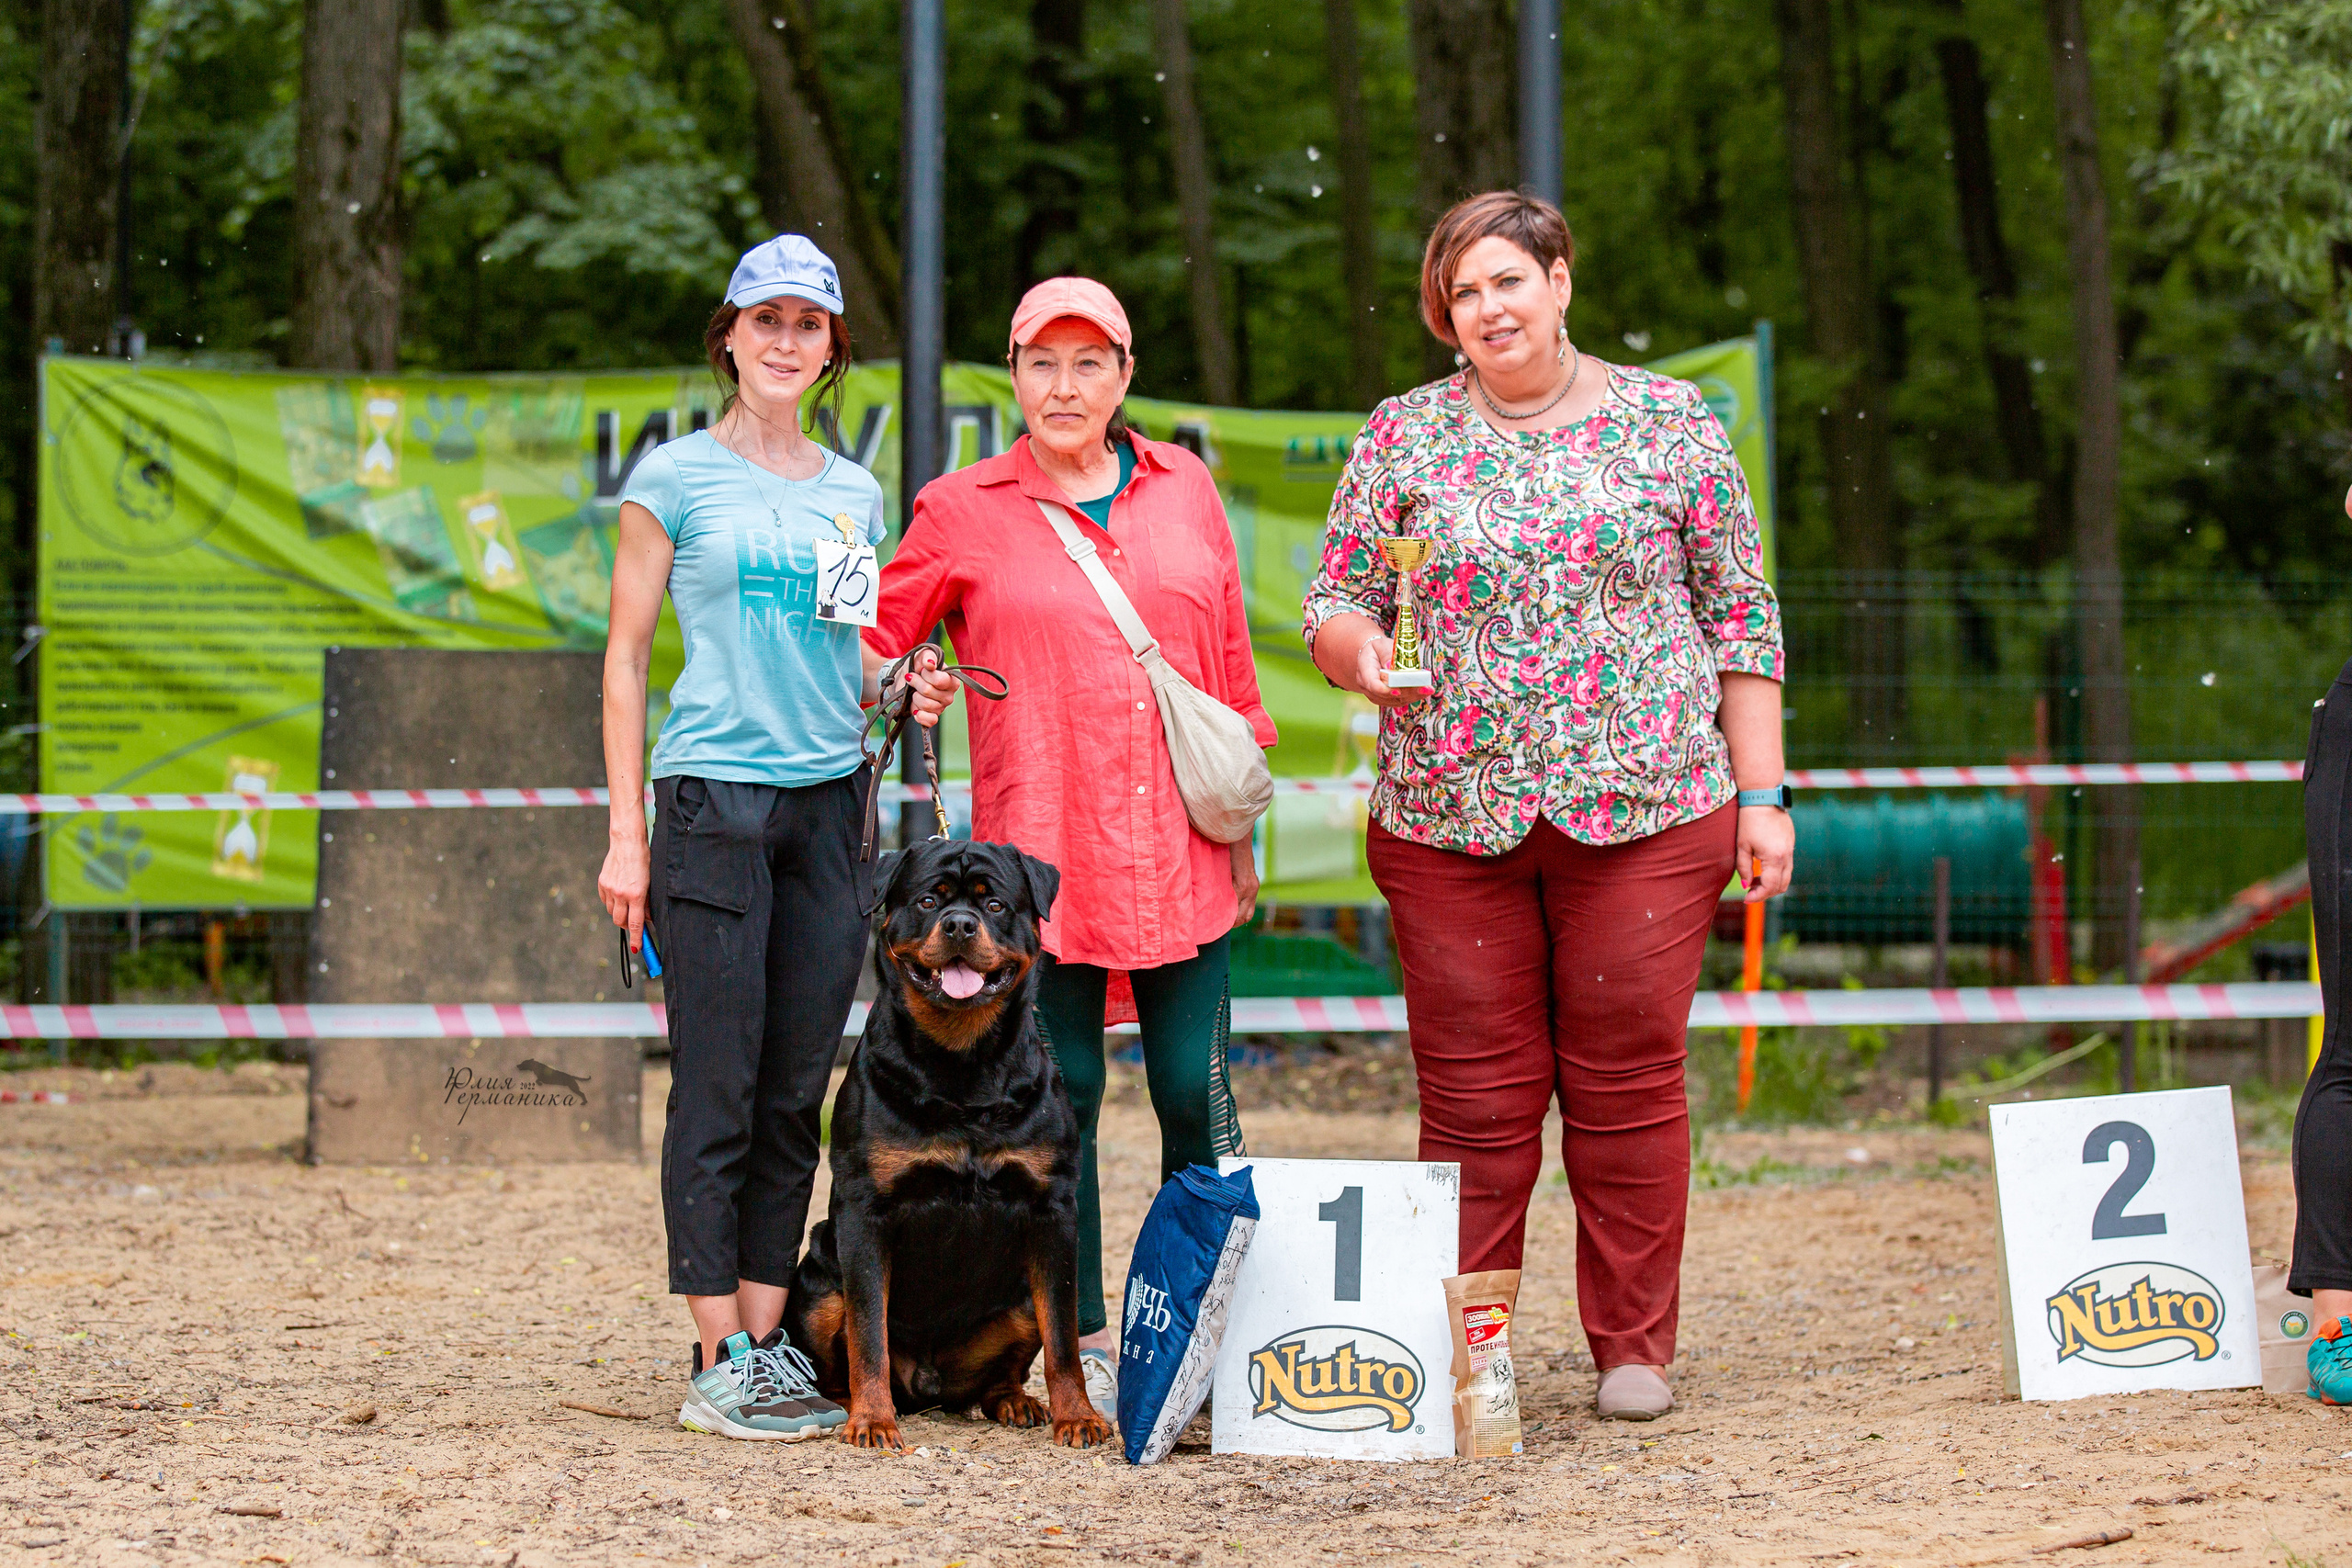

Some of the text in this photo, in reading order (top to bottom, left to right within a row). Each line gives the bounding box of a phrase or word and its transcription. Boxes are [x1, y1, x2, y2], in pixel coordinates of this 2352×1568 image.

[746, 527, 819, 574] RU
[779, 576, 818, 604] TH
[828, 552, 873, 606] 15
[2082, 1120, 2167, 1240] 2
[1318, 1186, 1363, 1302] 1
[2046, 1273, 2220, 1364] Nutro
[1250, 1341, 1416, 1433] Nutro
